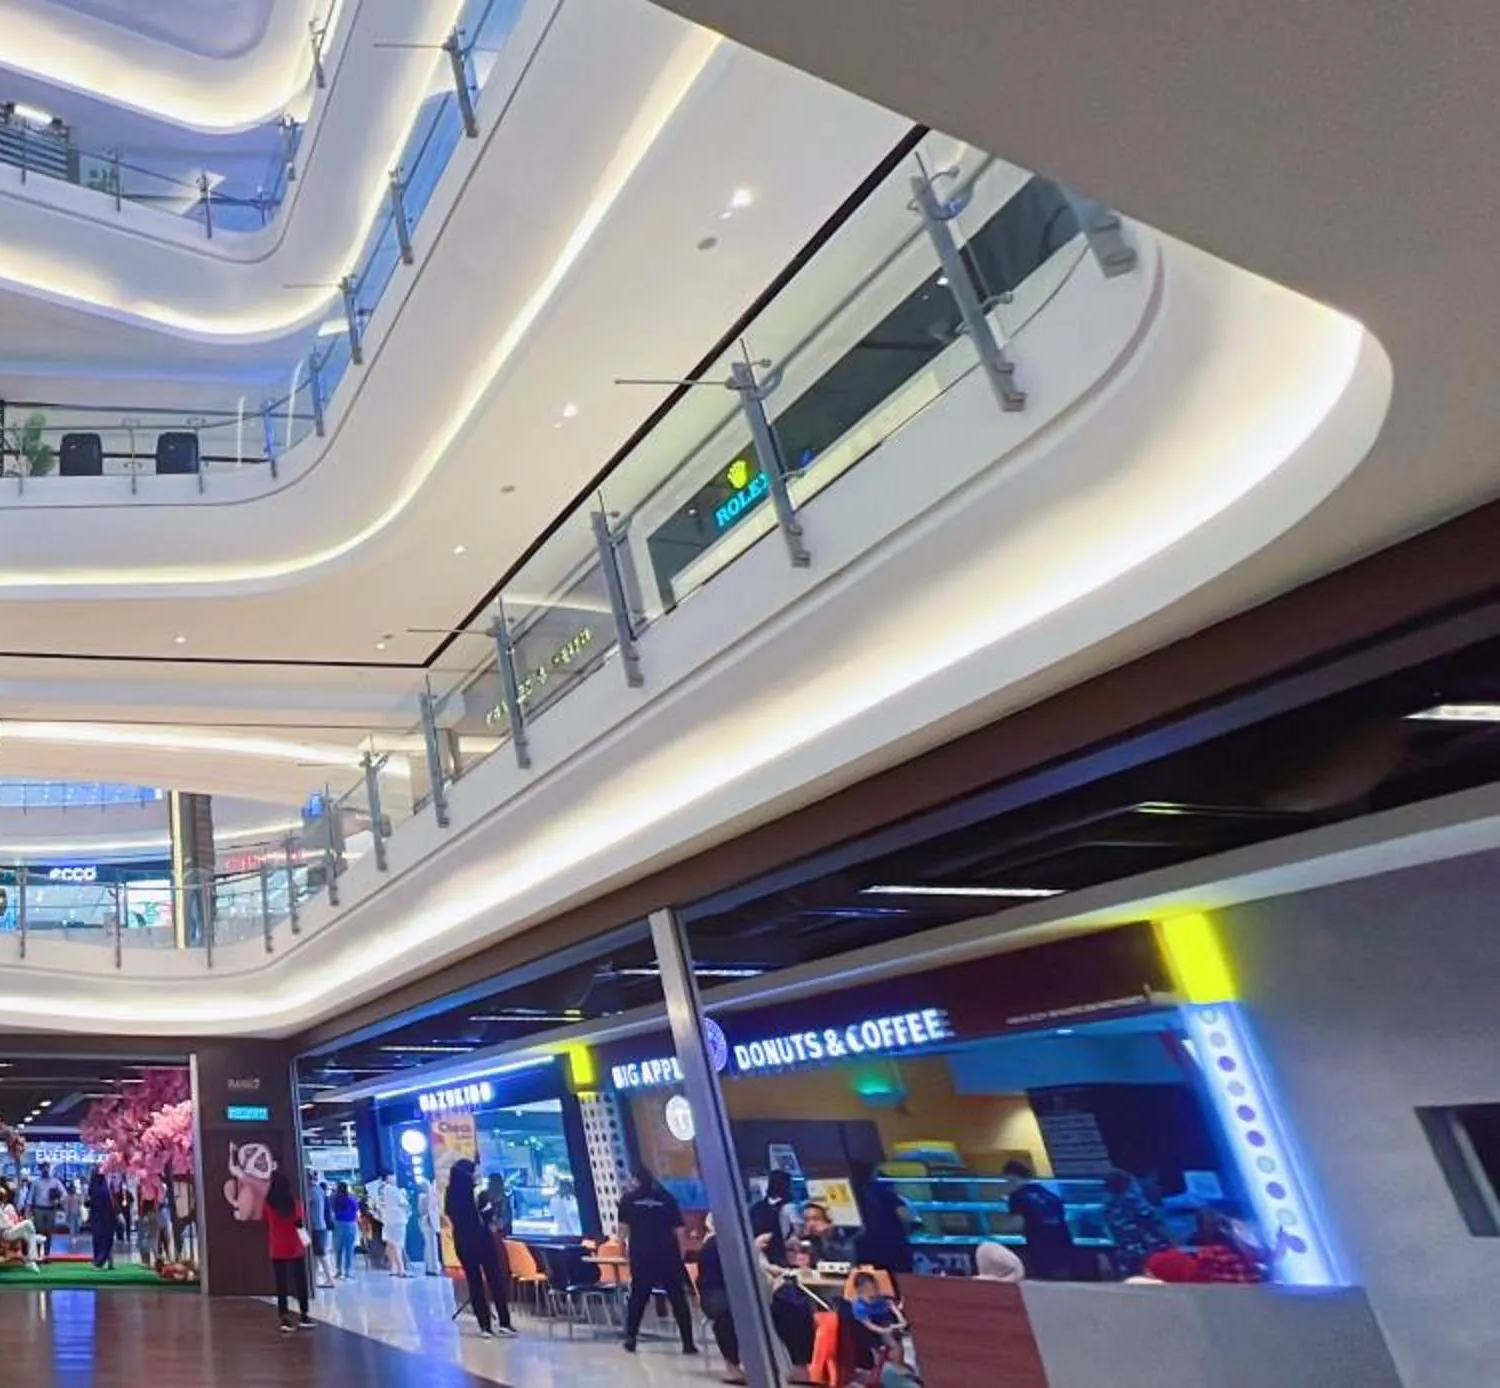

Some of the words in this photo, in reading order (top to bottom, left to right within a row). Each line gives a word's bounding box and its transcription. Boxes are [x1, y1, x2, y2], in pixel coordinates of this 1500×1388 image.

[733, 1031, 824, 1071] DONUTS
[823, 1028, 847, 1057] &
[844, 1008, 946, 1053] COFFEE
[612, 1063, 640, 1089] BIG
[641, 1056, 685, 1086] APPL
